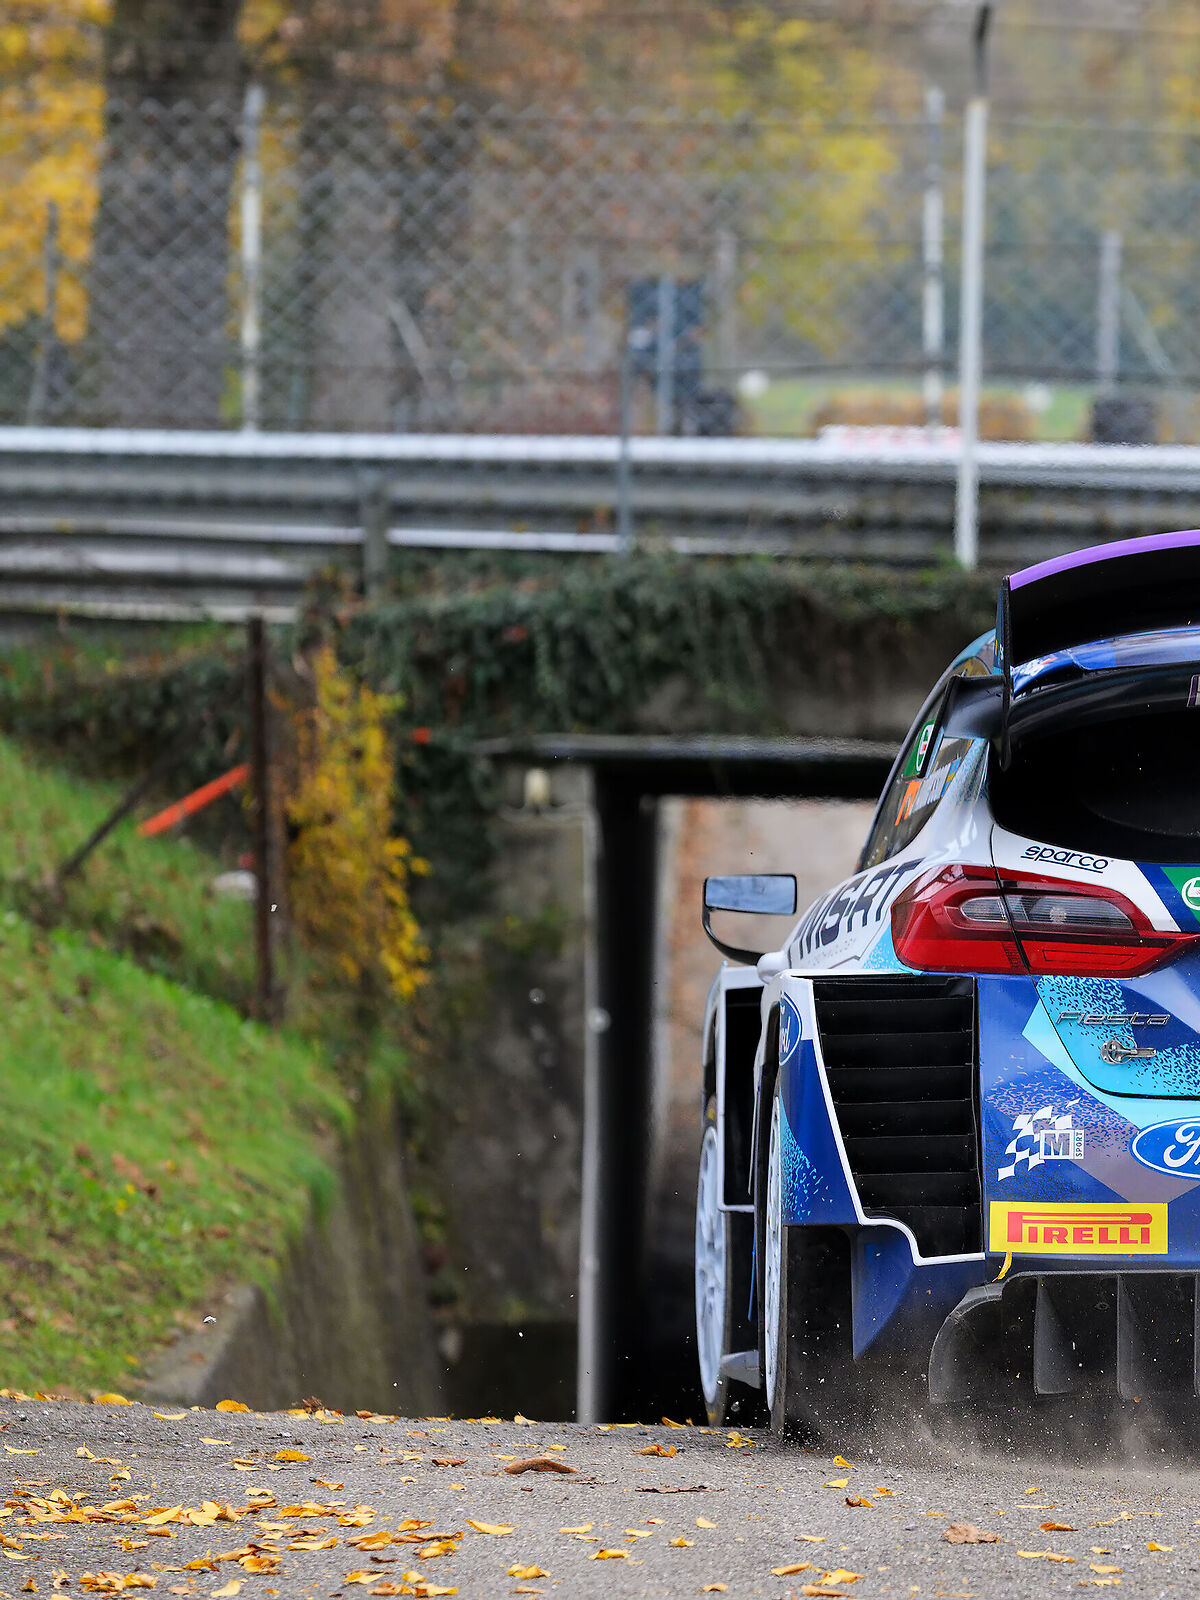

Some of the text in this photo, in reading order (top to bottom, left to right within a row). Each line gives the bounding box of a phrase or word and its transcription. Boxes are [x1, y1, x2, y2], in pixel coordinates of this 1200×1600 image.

[1023, 845, 1109, 871] sparco
[1075, 1131, 1083, 1158] SPORT
[1007, 1211, 1153, 1244] PIRELLI
